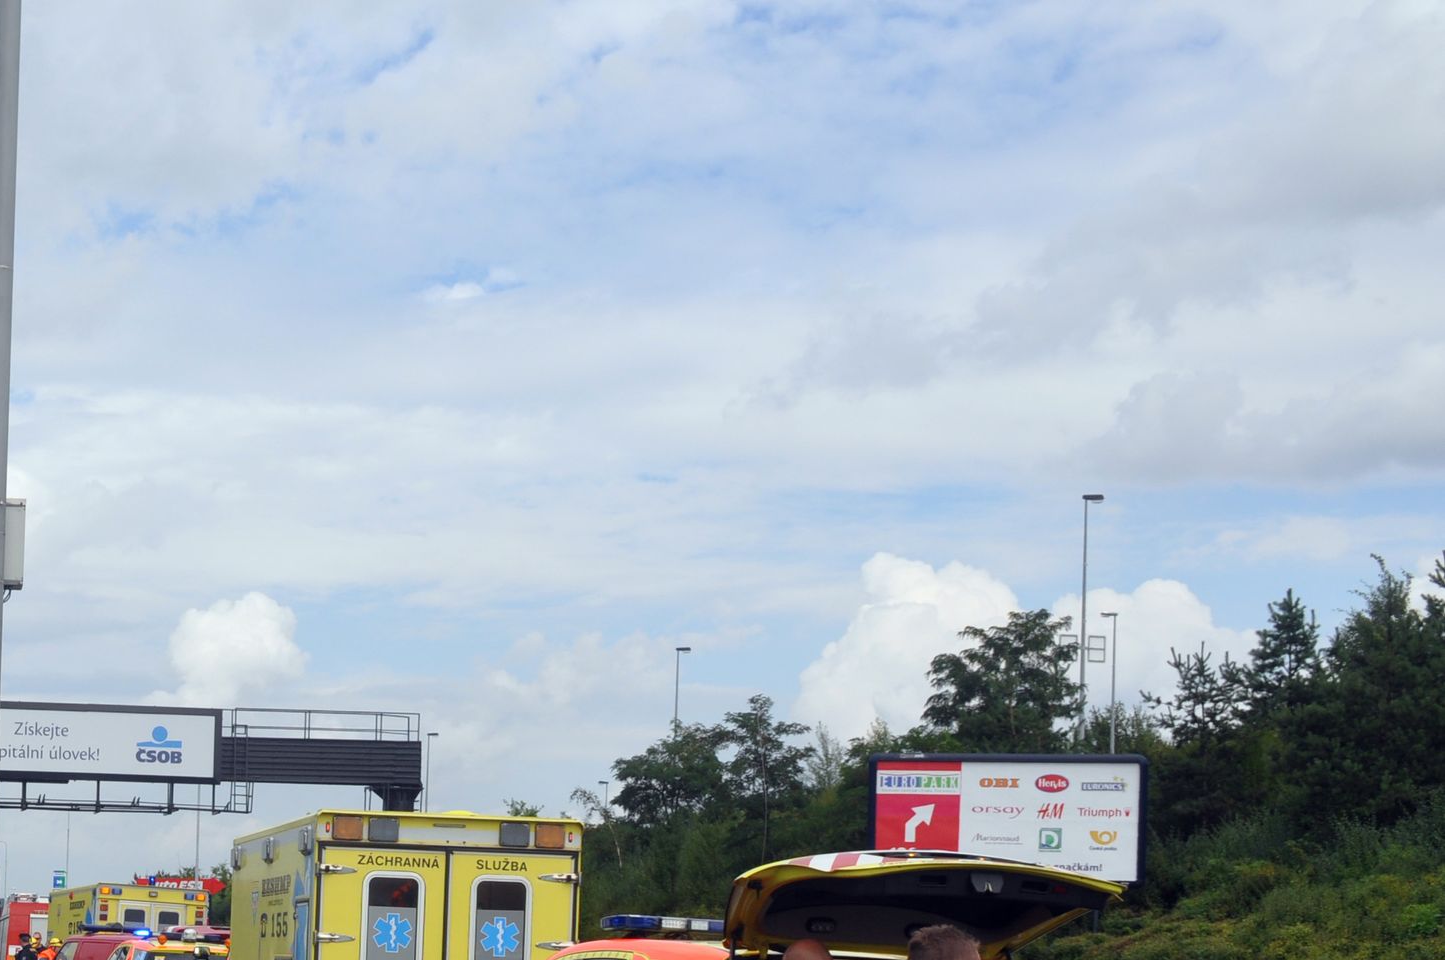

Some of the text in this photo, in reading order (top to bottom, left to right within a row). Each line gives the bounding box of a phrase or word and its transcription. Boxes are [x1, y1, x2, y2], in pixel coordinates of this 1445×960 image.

[14, 721, 69, 740] Získejte
[0, 745, 100, 761] pitální úlovek!
[135, 748, 183, 764] ČSOB
[979, 777, 1020, 788] OBI
[1037, 775, 1067, 789] Hervis
[1082, 782, 1124, 791] EURONICS
[971, 805, 1025, 819] orsay
[1037, 803, 1065, 819] H&M
[1077, 807, 1122, 818] Triumph
[971, 833, 1020, 842] Marionnaud
[357, 854, 528, 871] ZÁCHRANNÁ SLUŽBA
[271, 911, 289, 938] 155
